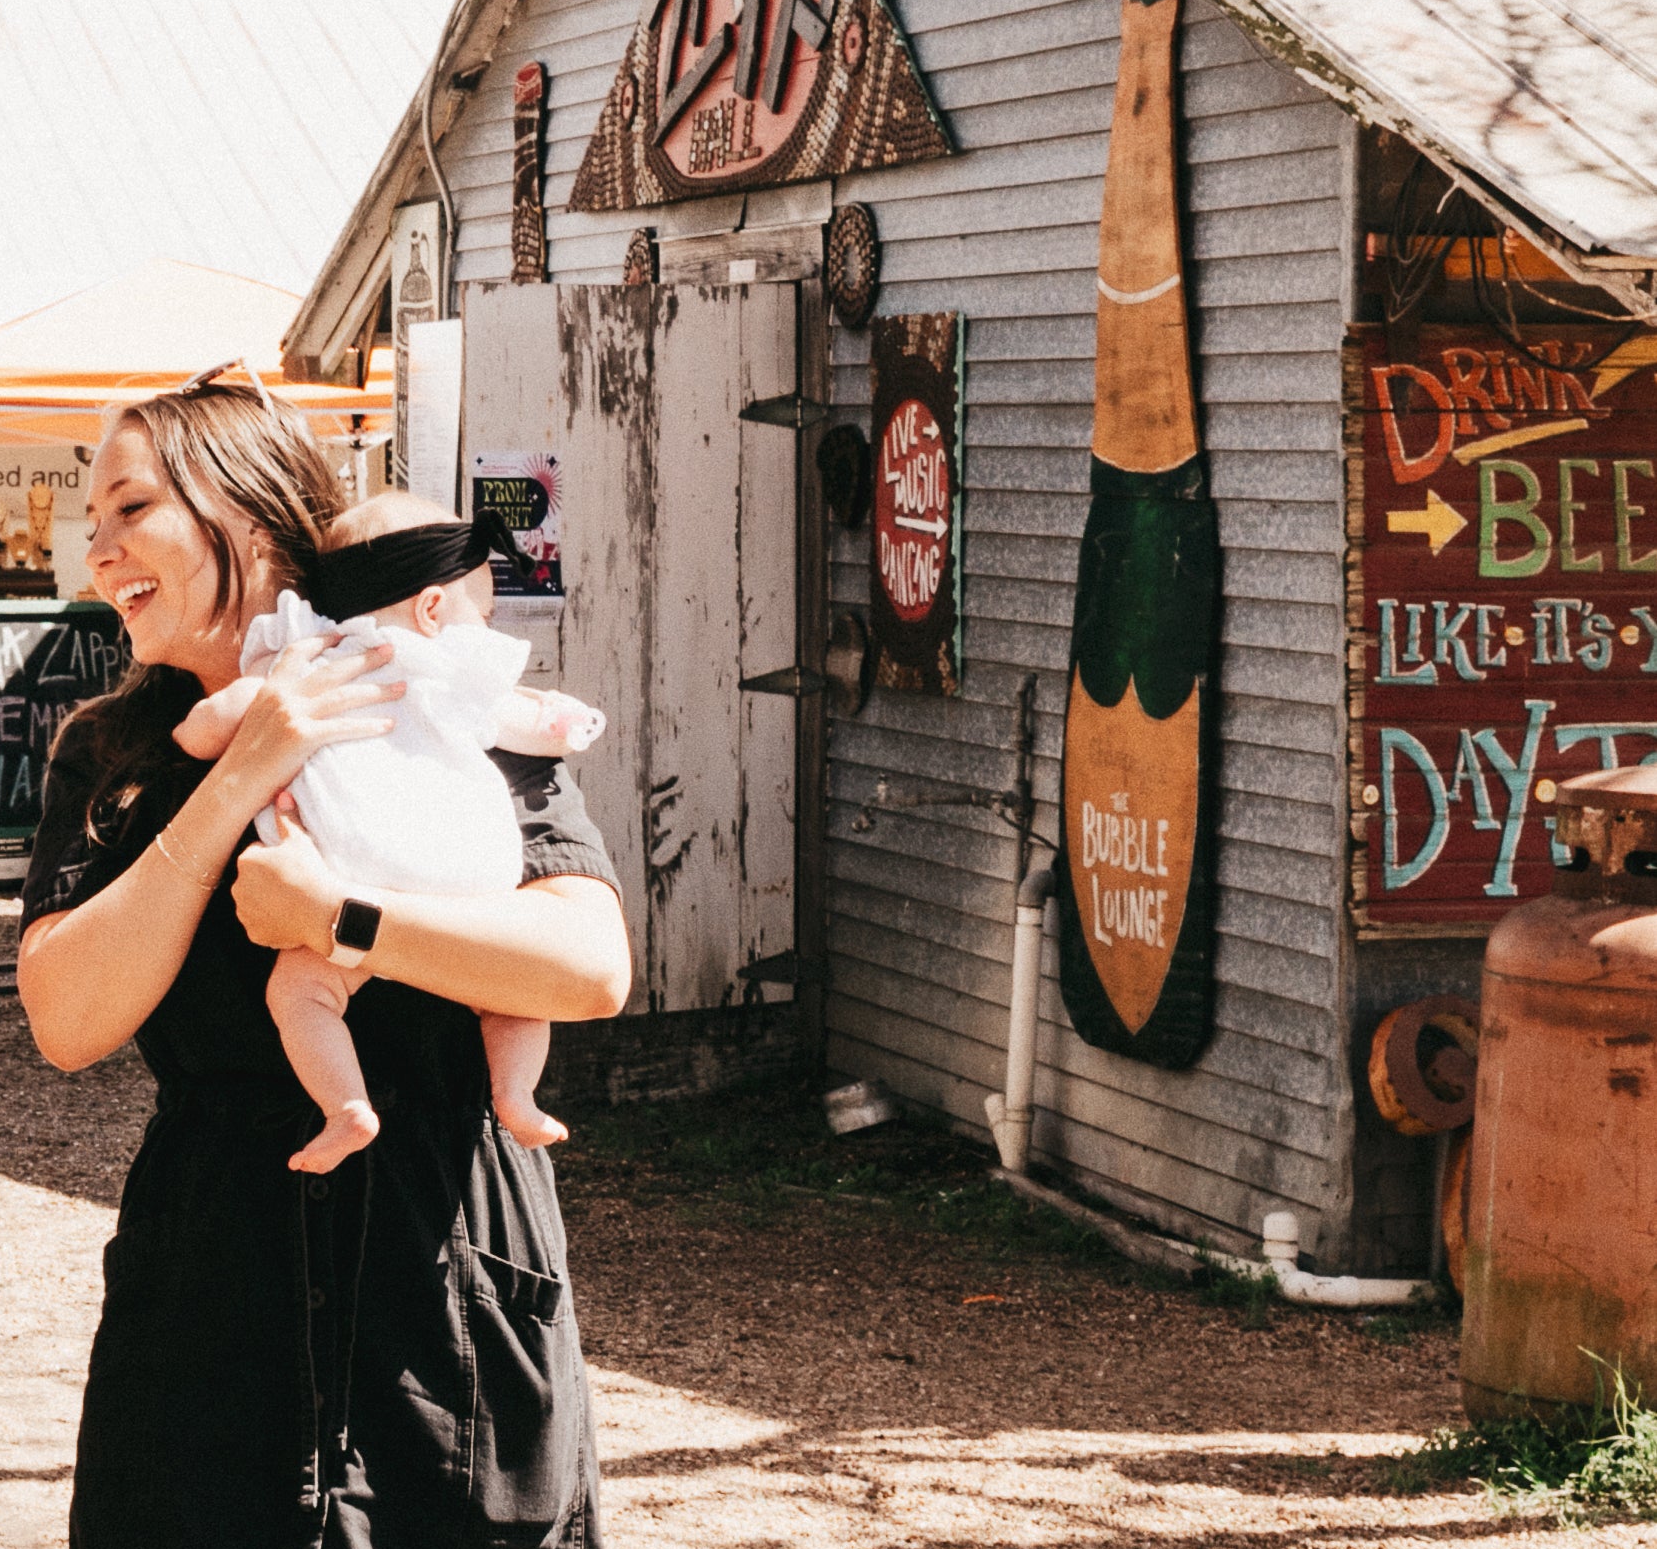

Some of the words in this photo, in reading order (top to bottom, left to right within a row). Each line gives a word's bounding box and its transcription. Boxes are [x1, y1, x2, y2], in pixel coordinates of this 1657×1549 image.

[883, 403, 919, 484] LIVE
[1371, 340, 1612, 485] DRINK
[31, 467, 80, 488] and
[482, 480, 528, 503] PROM
[894, 448, 947, 515] MUSIC
[484, 506, 533, 528] GHT
[880, 530, 940, 606] DANCING
[1374, 598, 1507, 686] LIKE
[1380, 699, 1556, 897] DAY
[1082, 800, 1169, 878] BUBBLE
[1092, 873, 1169, 948] LOUNGE
